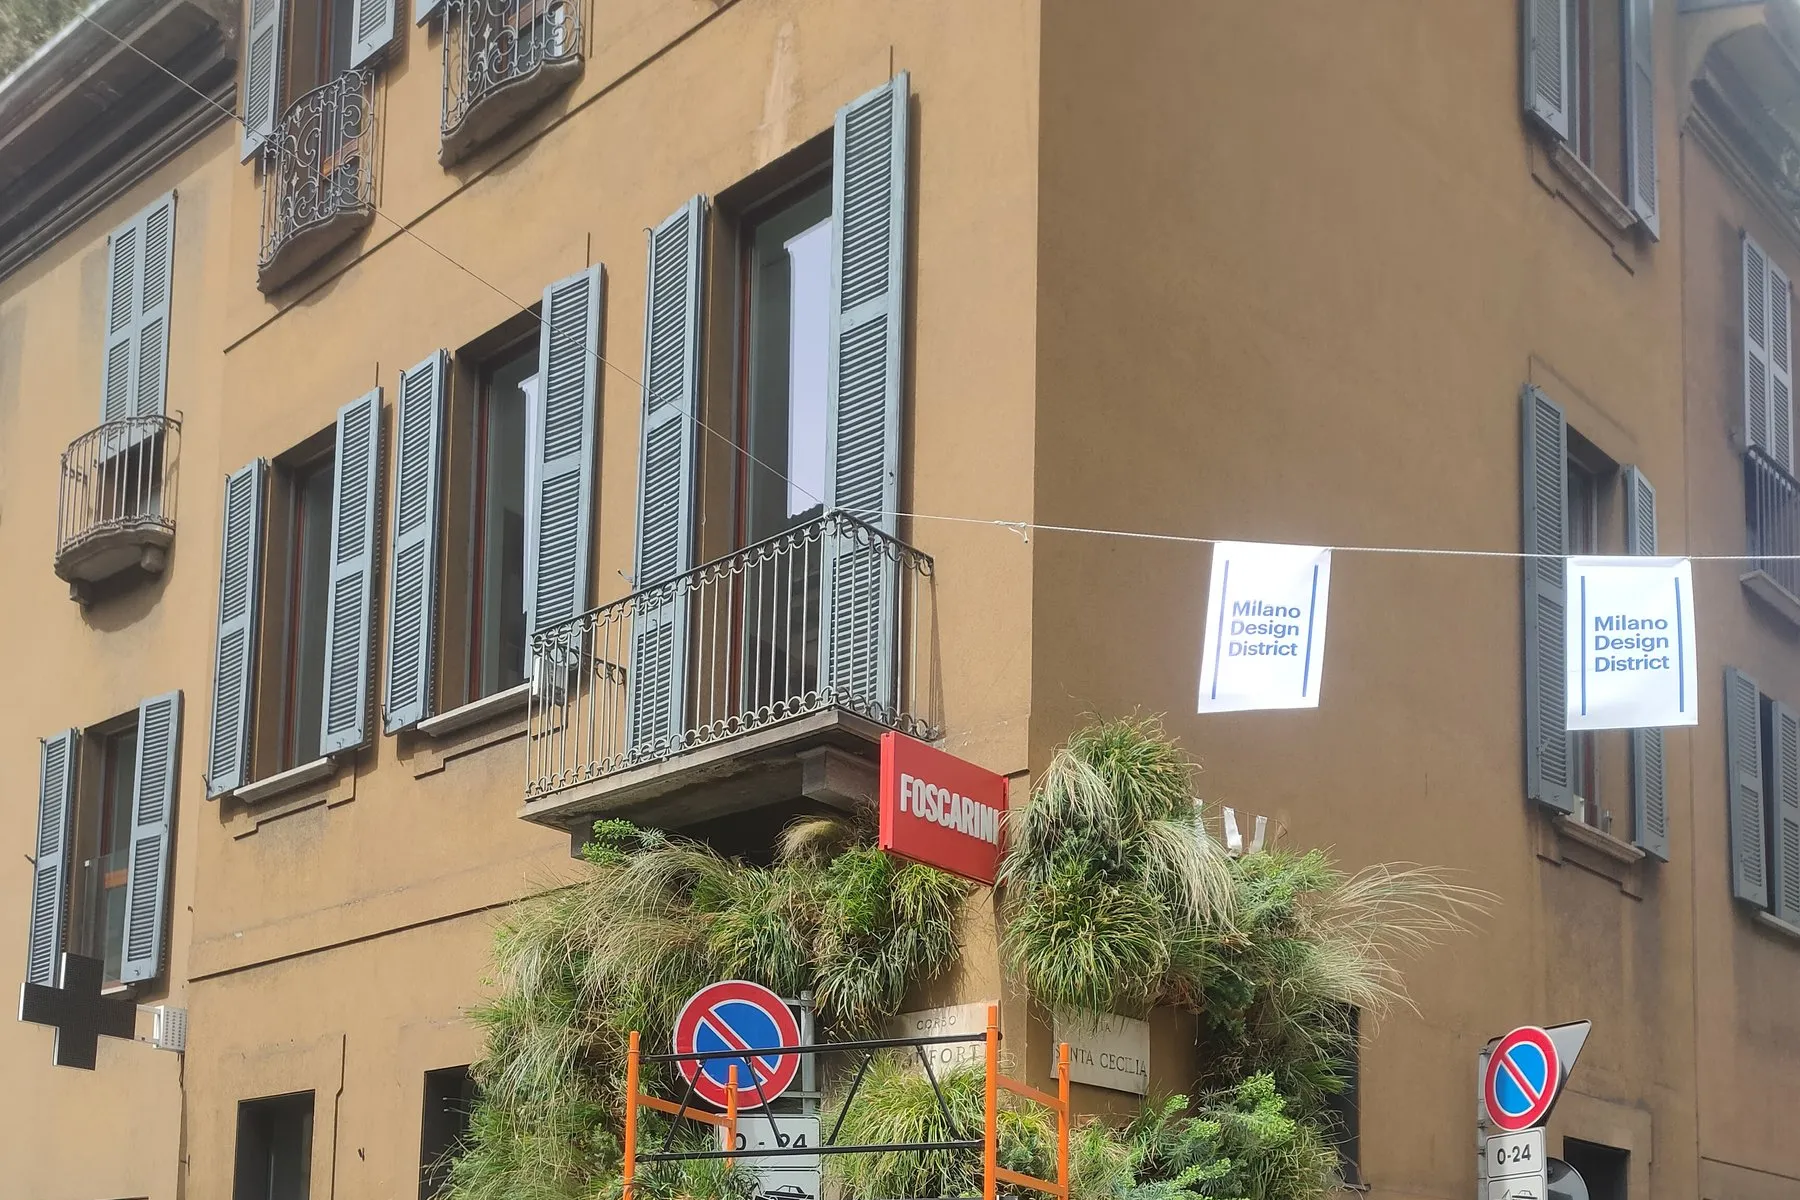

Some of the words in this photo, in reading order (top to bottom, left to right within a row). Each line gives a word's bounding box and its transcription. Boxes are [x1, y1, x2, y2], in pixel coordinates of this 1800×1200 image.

[1232, 599, 1301, 619] Milano
[1230, 619, 1300, 639] Design
[1594, 614, 1668, 632] Milano
[1228, 639, 1299, 657] District
[1594, 632, 1669, 652] Design
[1594, 653, 1670, 673] District
[900, 773, 999, 846] FOSCARINI
[916, 1015, 957, 1031] CORSO
[1055, 1044, 1095, 1066] SNTA
[1099, 1053, 1148, 1077] CECILIA
[1497, 1143, 1532, 1166] 0-24
